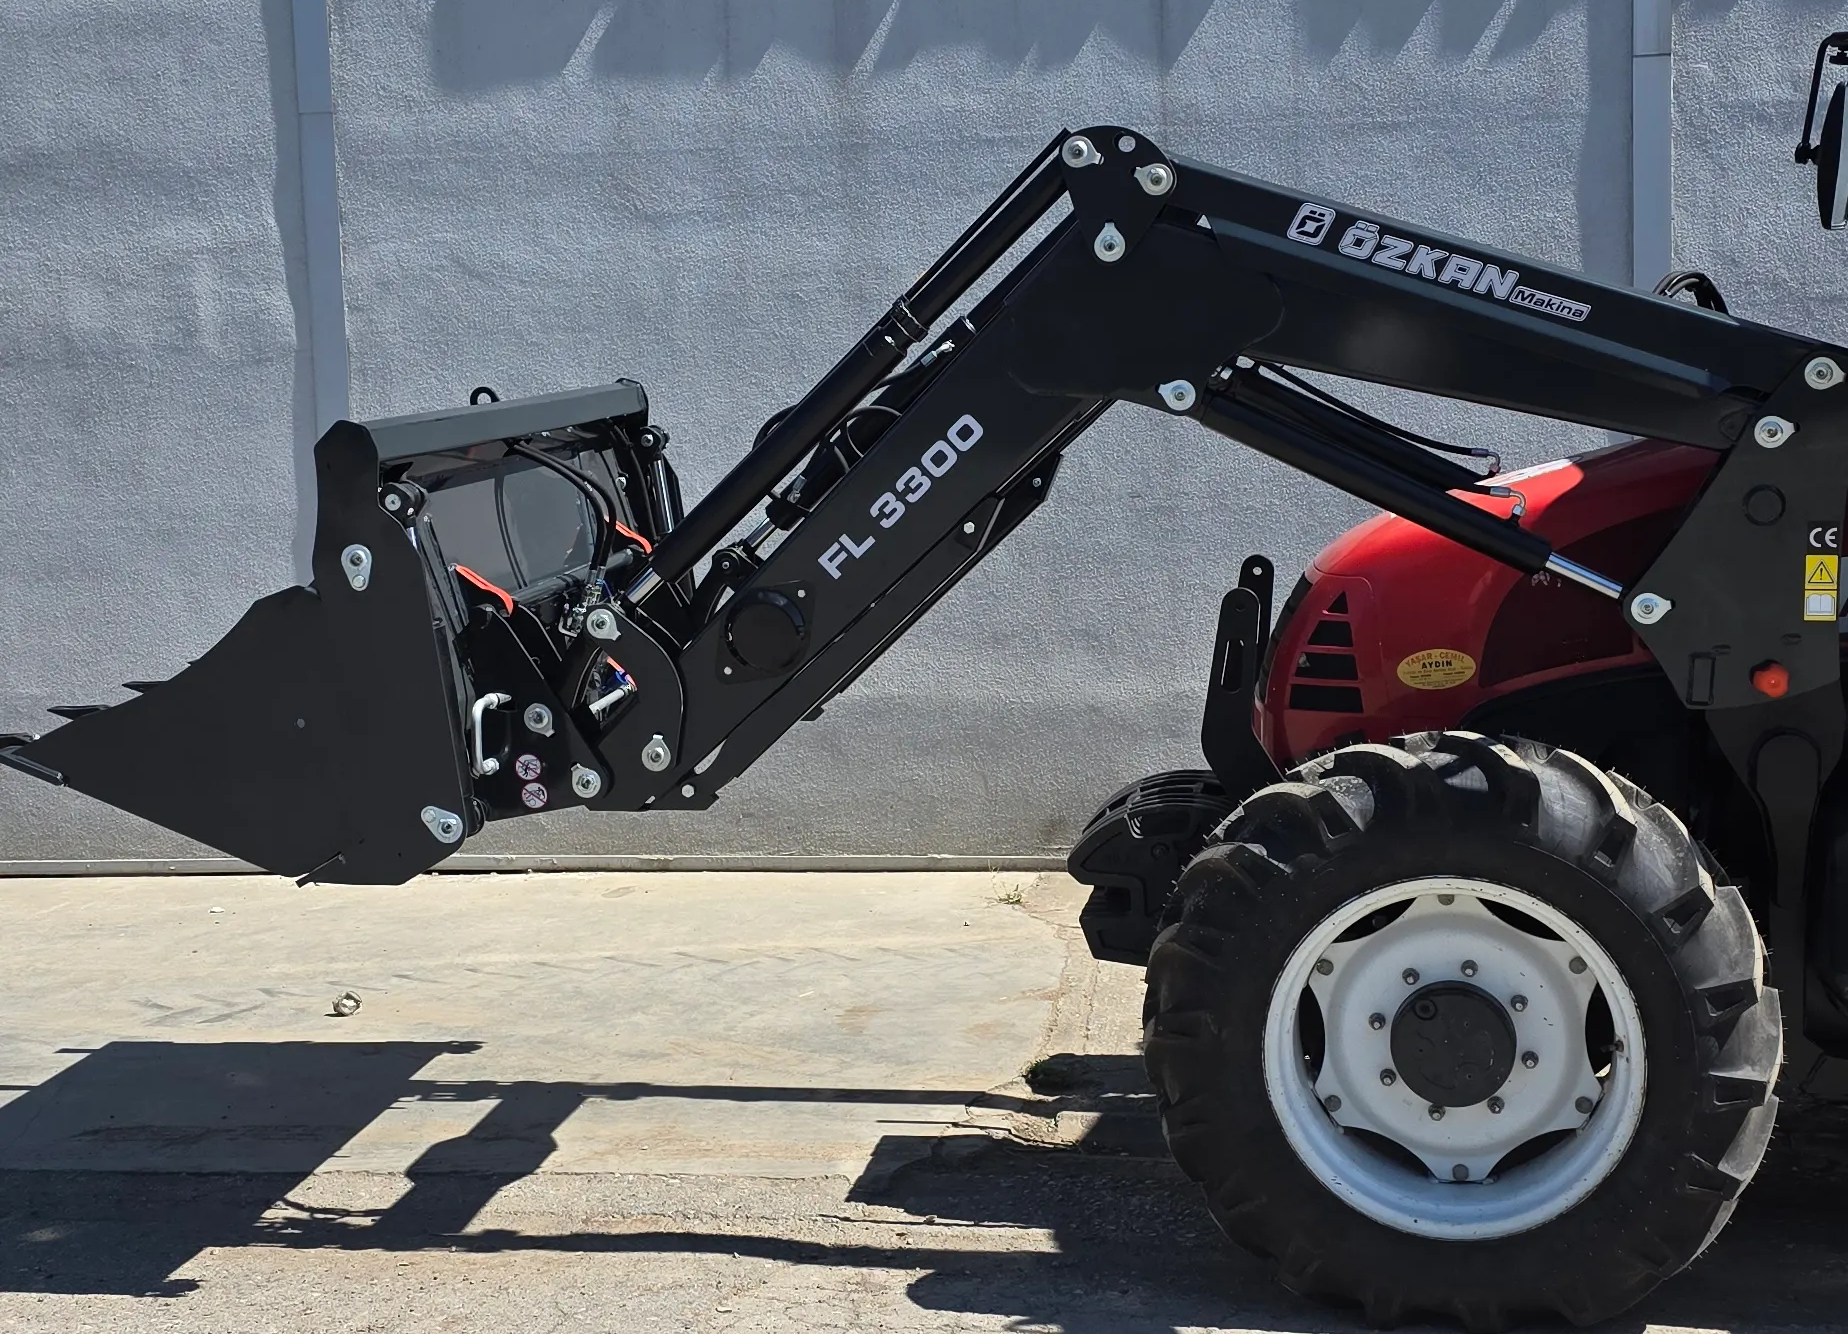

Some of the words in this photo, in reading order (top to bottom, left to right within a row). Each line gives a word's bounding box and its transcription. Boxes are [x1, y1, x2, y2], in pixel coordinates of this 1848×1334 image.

[1338, 219, 1520, 301] ÖZKAN
[1512, 288, 1586, 319] Makina
[817, 533, 876, 580] FL
[869, 413, 984, 529] 3300
[1808, 527, 1838, 548] CE
[1421, 660, 1452, 669] AYDIN
